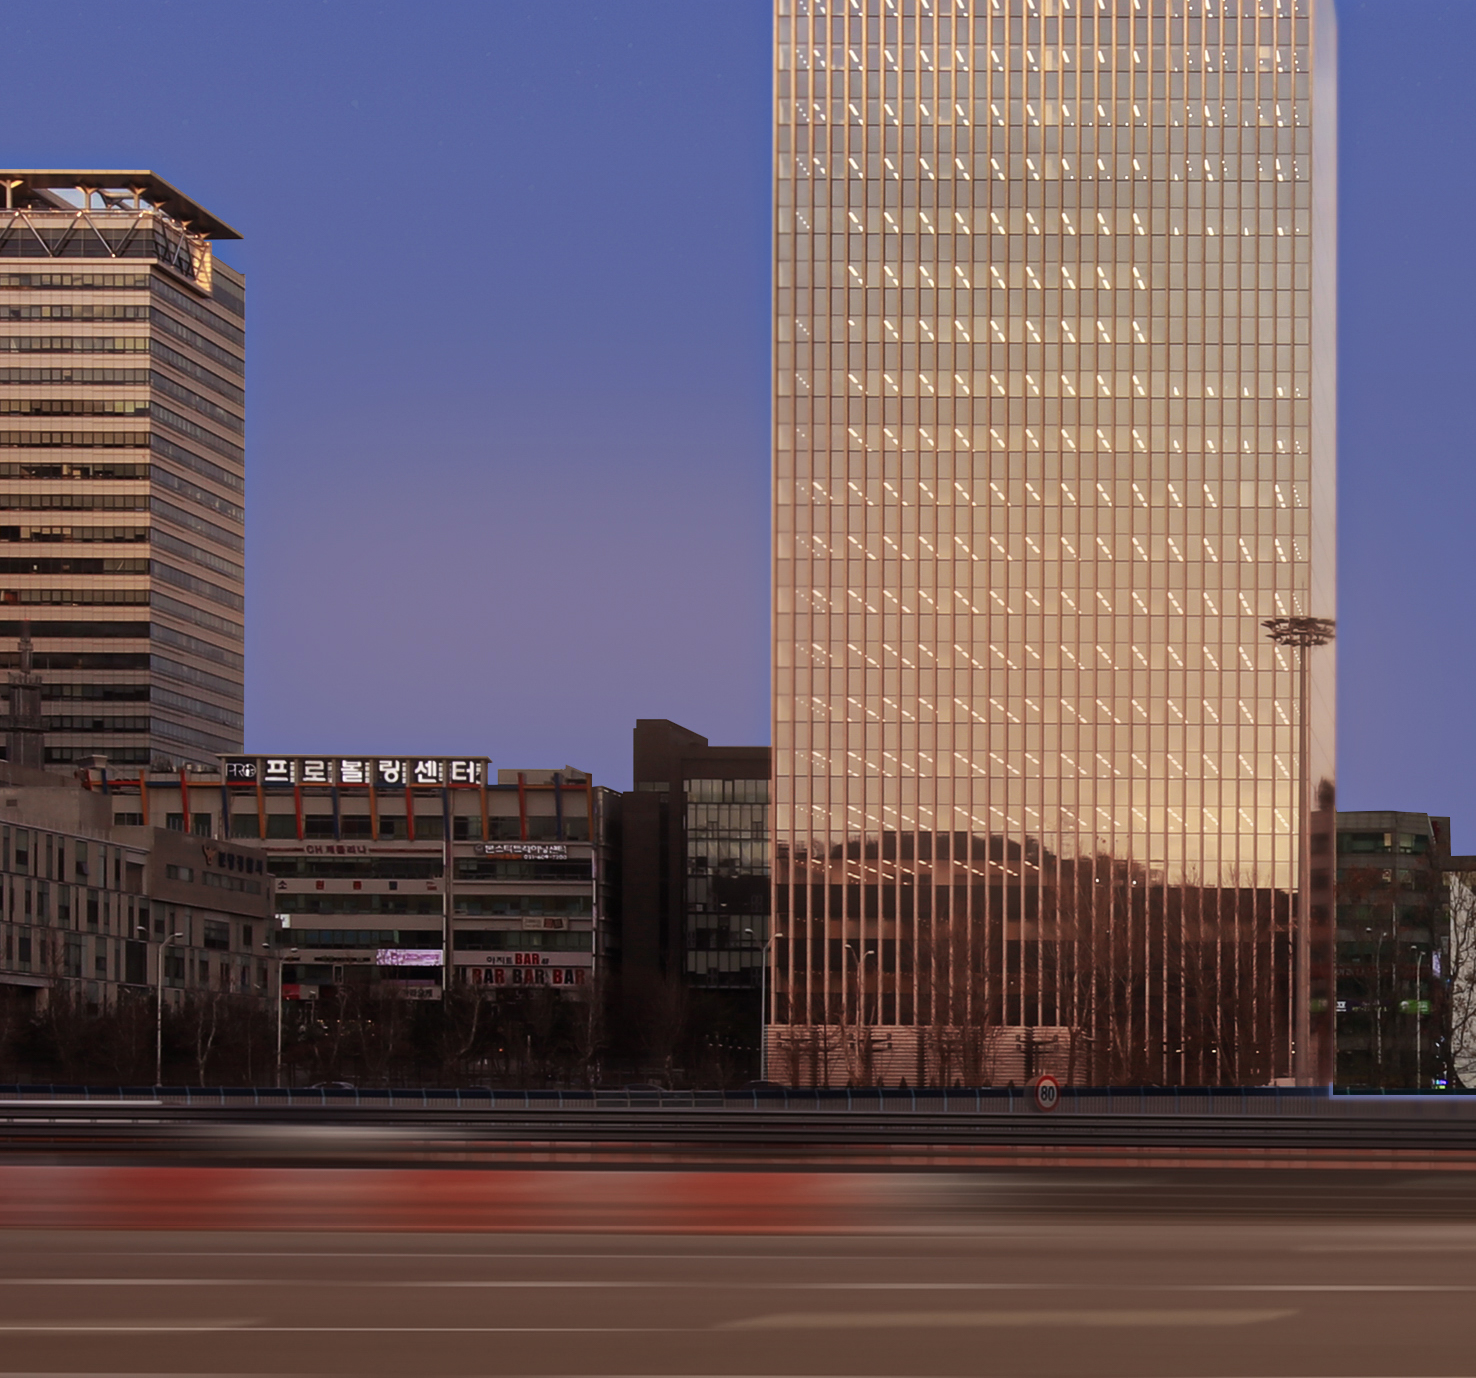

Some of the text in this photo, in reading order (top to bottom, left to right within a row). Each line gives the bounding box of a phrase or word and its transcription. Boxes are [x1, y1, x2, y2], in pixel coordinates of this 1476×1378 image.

[264, 759, 475, 784] 프로볼링센터
[515, 953, 540, 965] BAR
[472, 968, 586, 985] BAR BAR BAR
[1041, 1086, 1055, 1101] 80
